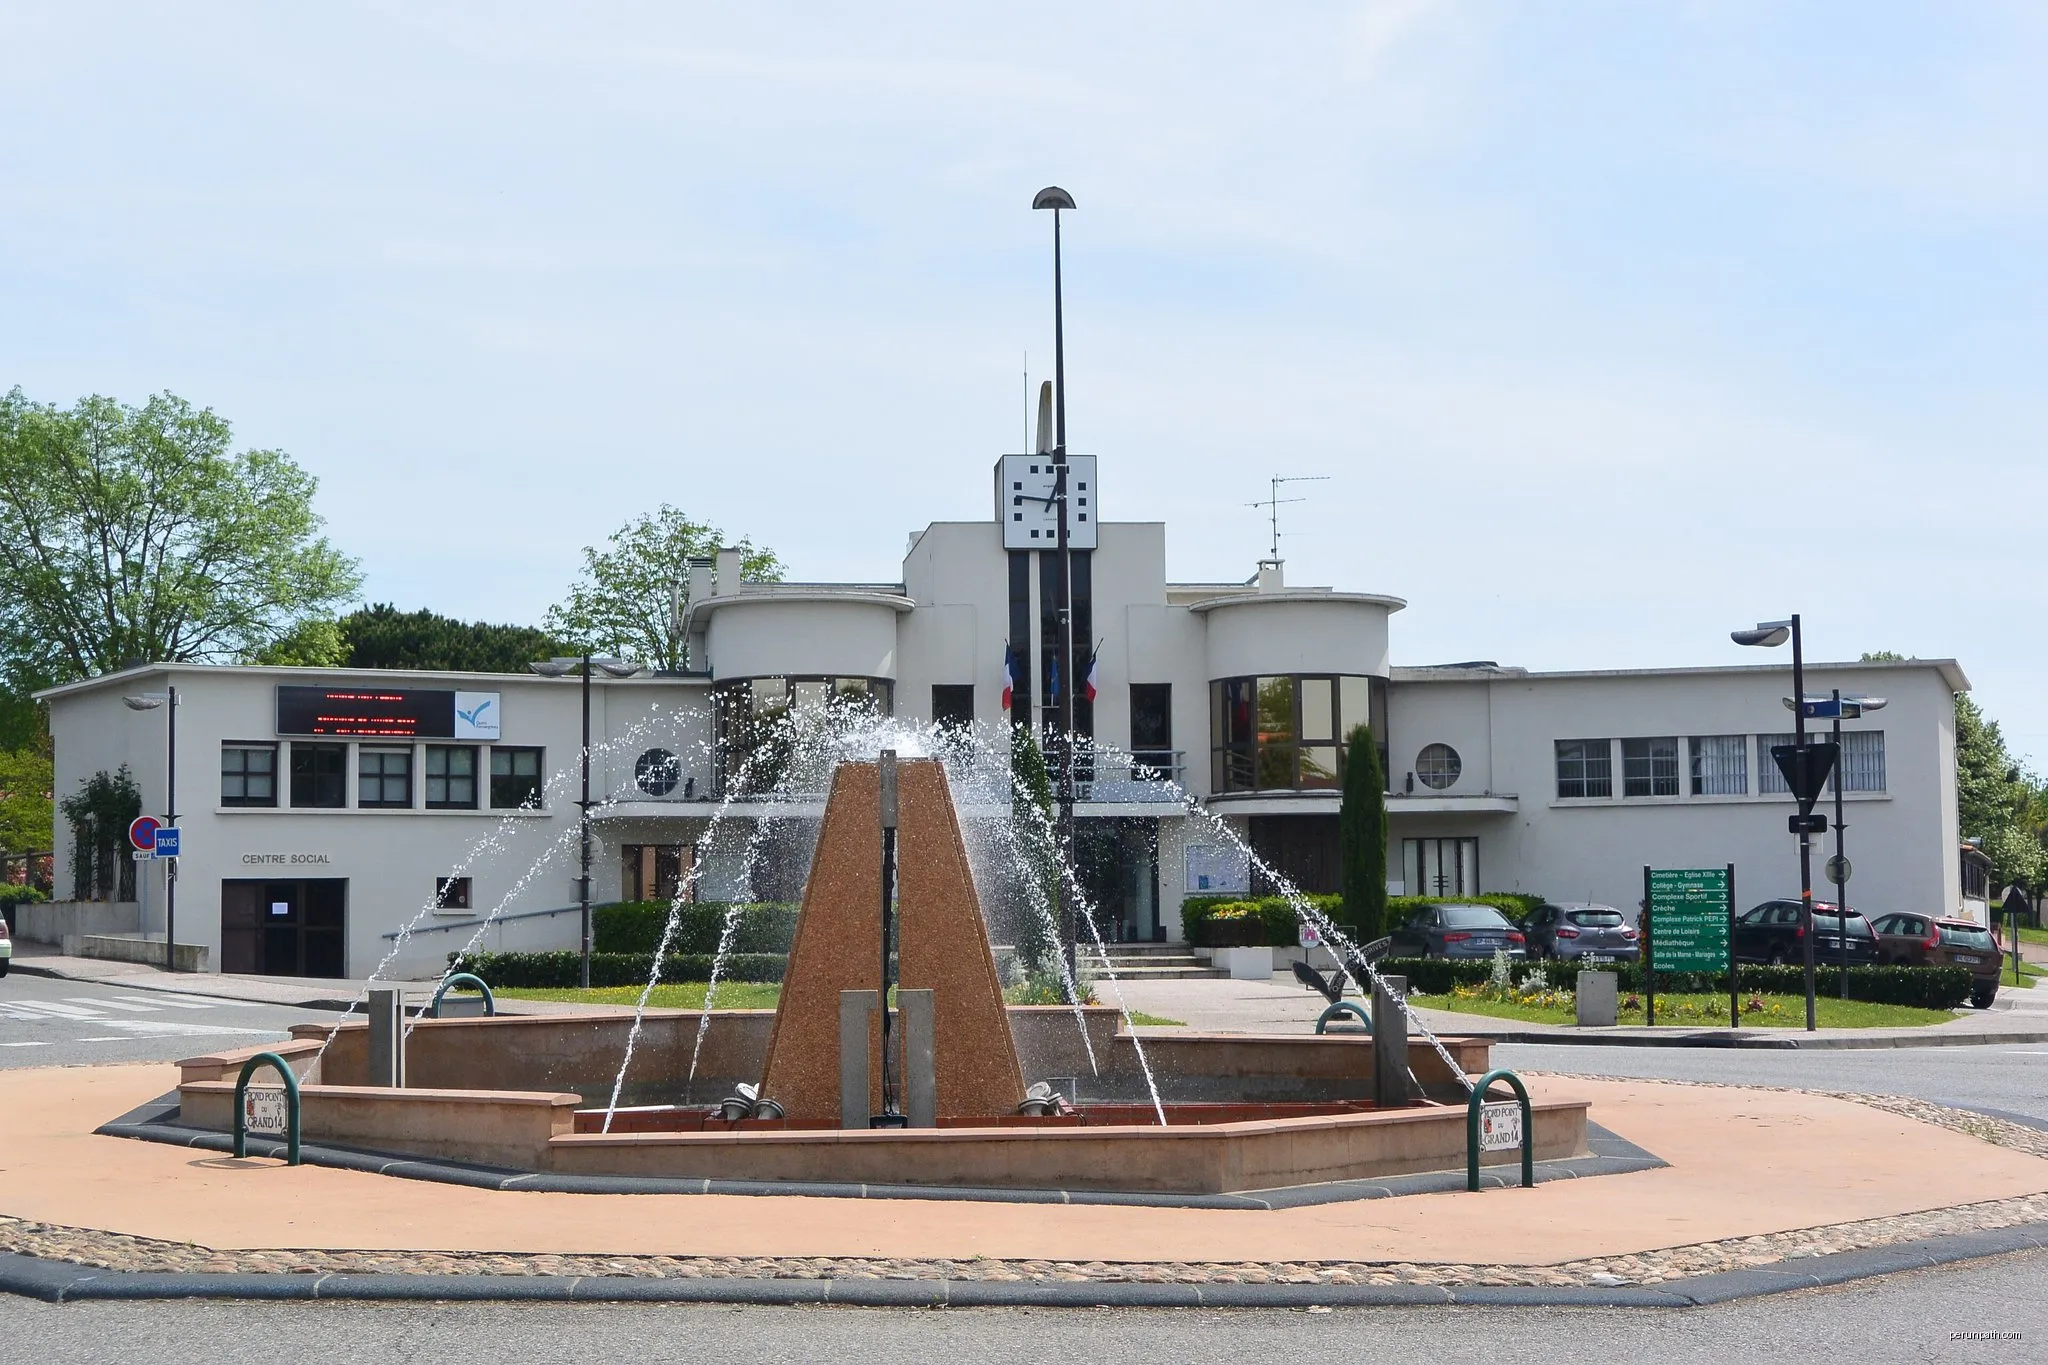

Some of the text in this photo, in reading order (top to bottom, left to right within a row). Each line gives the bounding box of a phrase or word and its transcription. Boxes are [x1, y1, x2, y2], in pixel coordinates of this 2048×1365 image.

[157, 837, 178, 847] TAXIS
[242, 854, 330, 864] CENTRE SOCIAL
[1652, 882, 1673, 890] Collège
[1677, 882, 1704, 890] Gymnase
[247, 1116, 274, 1129] GRAND
[1485, 1132, 1510, 1145] GRAND
